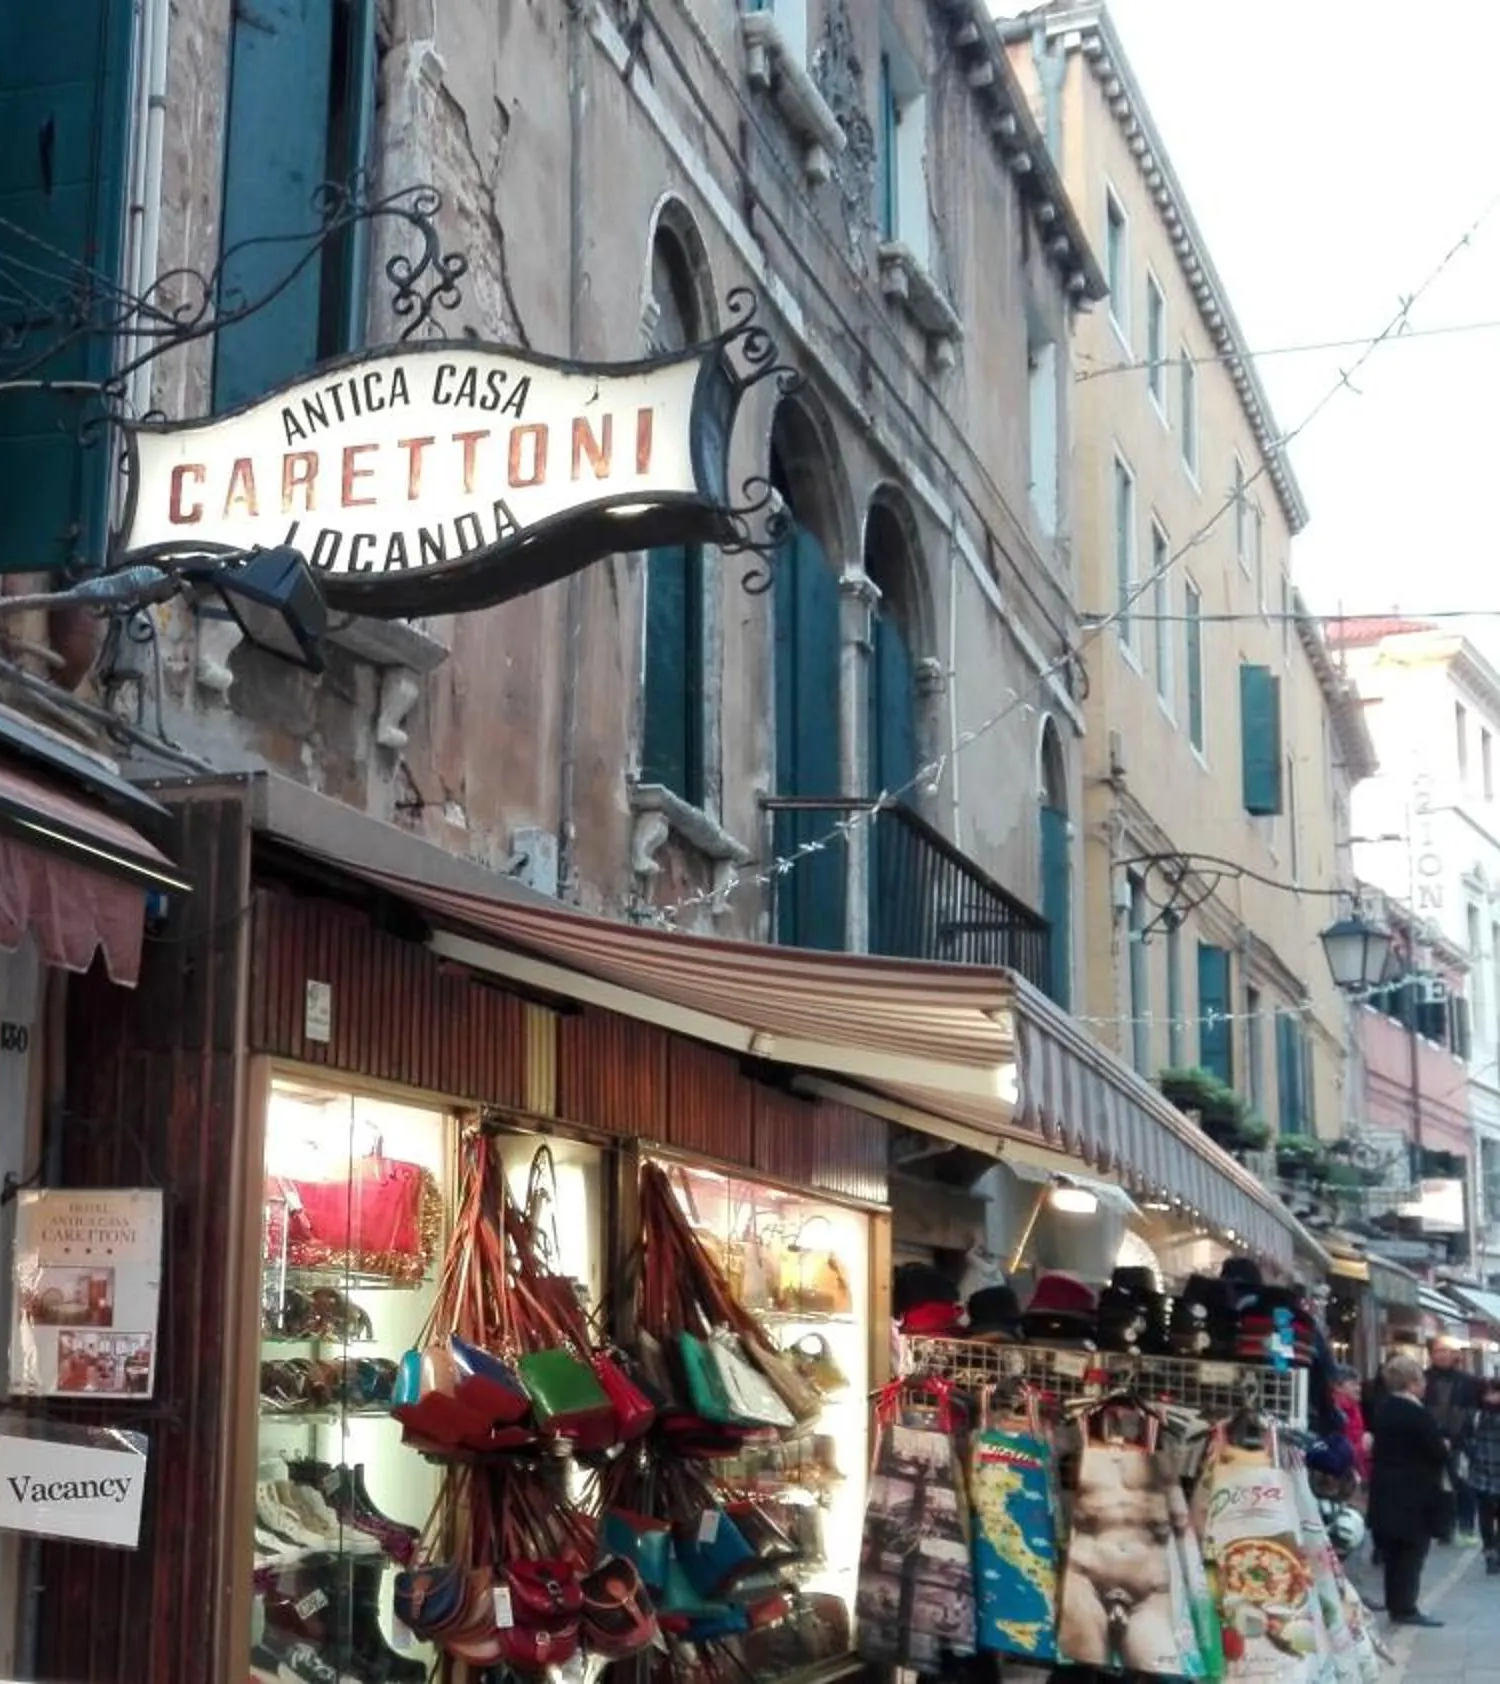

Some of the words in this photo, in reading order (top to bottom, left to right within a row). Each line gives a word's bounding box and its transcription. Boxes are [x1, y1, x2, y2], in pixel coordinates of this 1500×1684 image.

[281, 366, 411, 446] ANTICA
[432, 363, 532, 418] CASA
[168, 407, 654, 525] CARETTONI
[41, 1228, 137, 1243] CARETTONI
[7, 1475, 132, 1504] Vacancy
